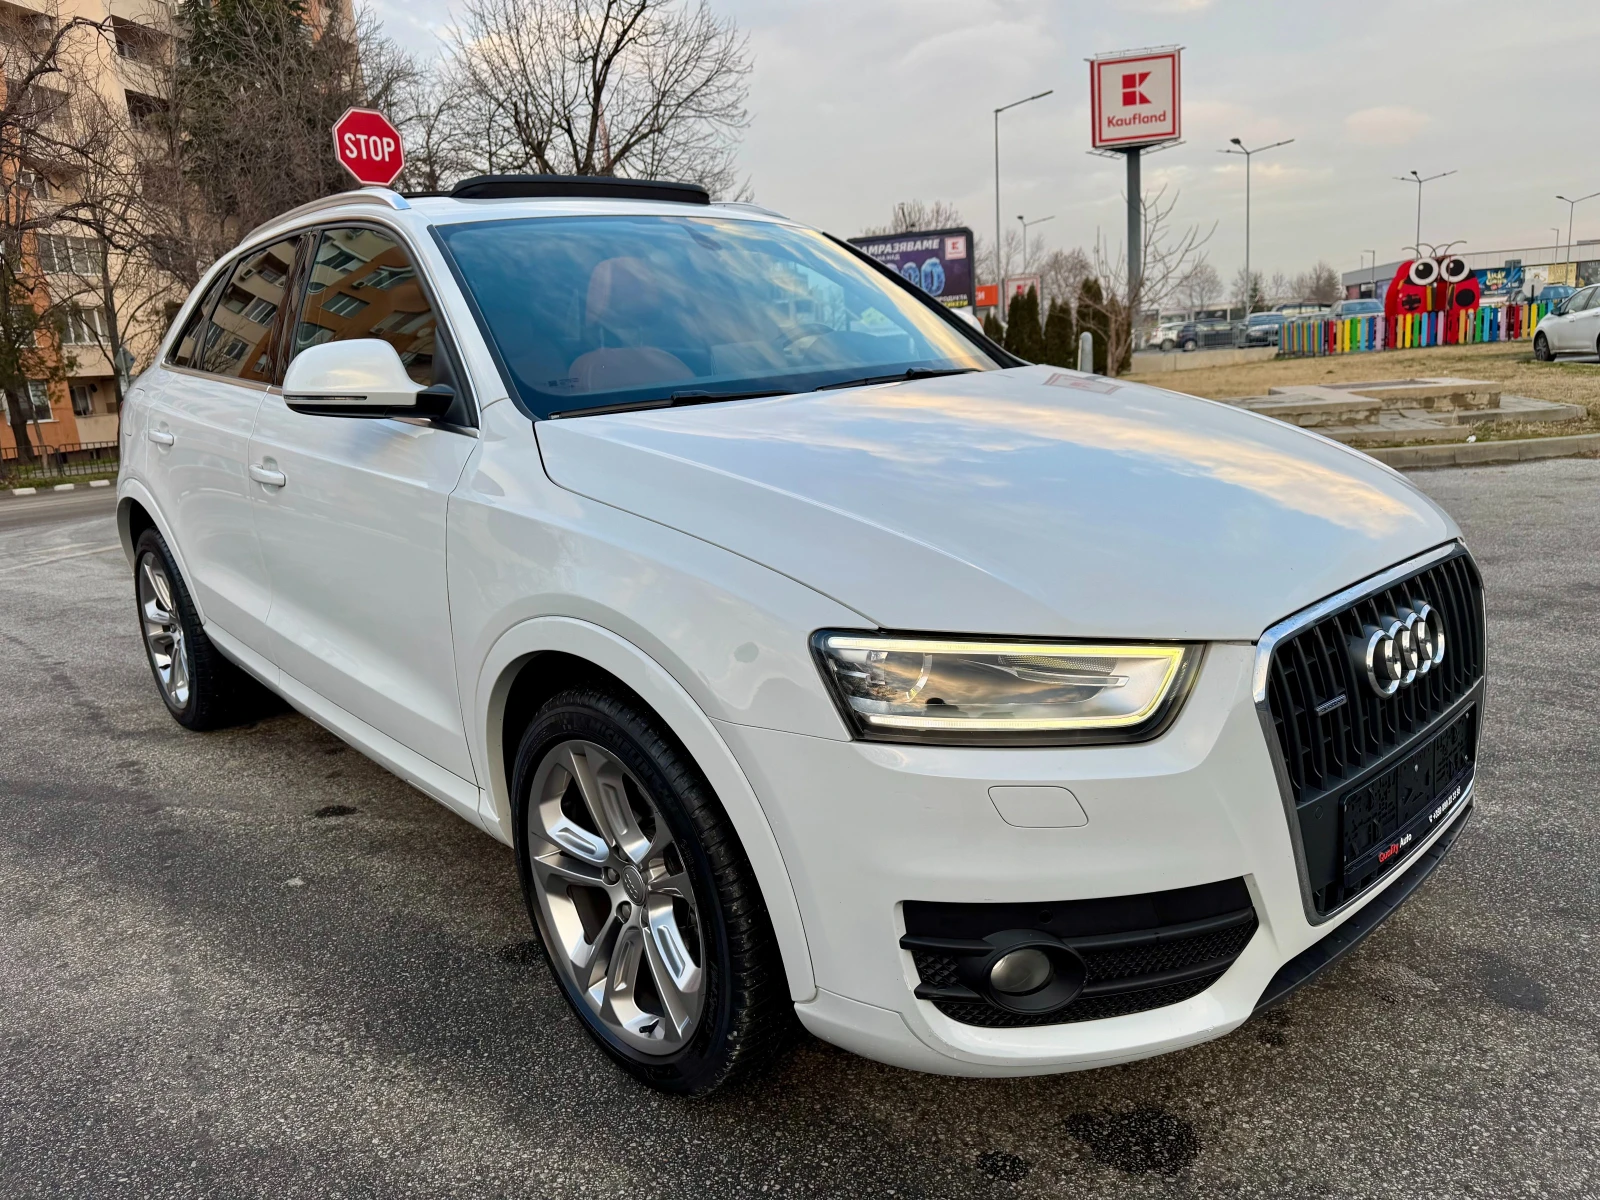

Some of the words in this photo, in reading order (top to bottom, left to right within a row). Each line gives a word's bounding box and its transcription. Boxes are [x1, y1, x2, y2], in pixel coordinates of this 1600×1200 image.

[1107, 110, 1167, 128] Kaufland
[344, 133, 395, 162] STOP
[859, 238, 940, 255] АМРАЗЯВАМЕ
[588, 718, 654, 782] MICHELIN
[1378, 843, 1399, 863] Quality
[1400, 833, 1412, 849] Auto
